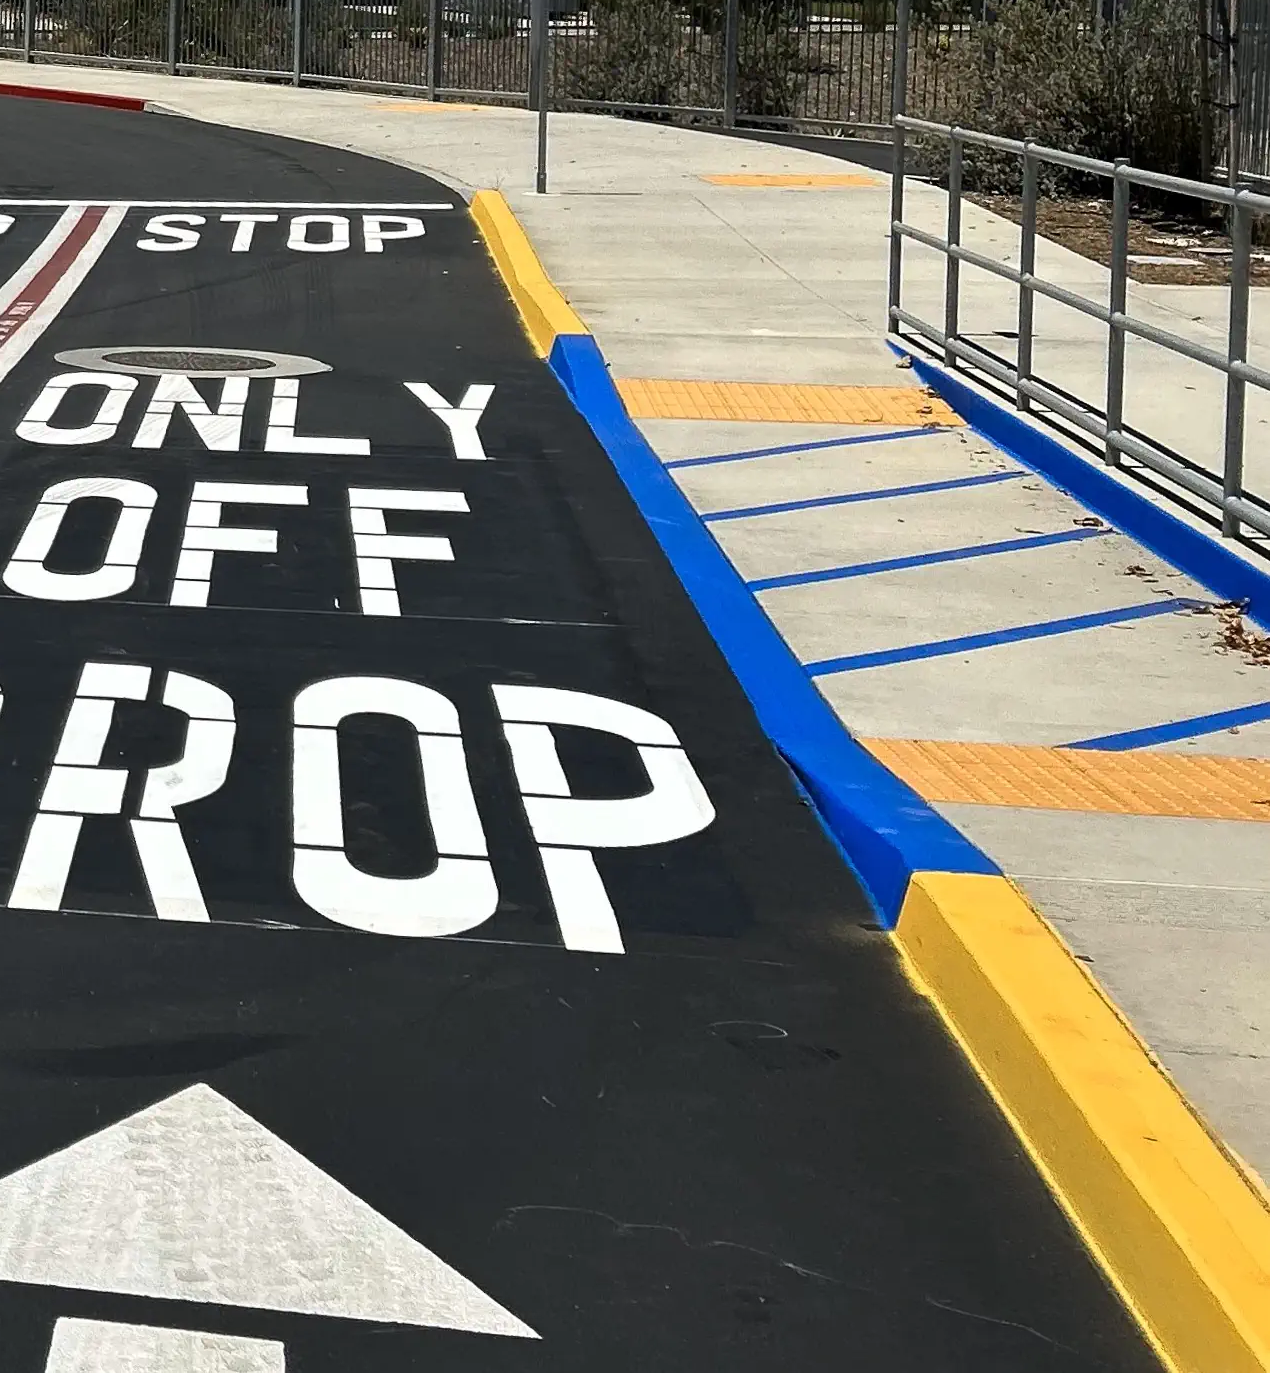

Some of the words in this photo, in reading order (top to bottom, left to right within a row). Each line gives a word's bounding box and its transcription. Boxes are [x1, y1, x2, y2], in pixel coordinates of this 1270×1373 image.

[137, 213, 425, 253] STOP
[16, 372, 496, 461] ONLY
[3, 477, 470, 617] OFF
